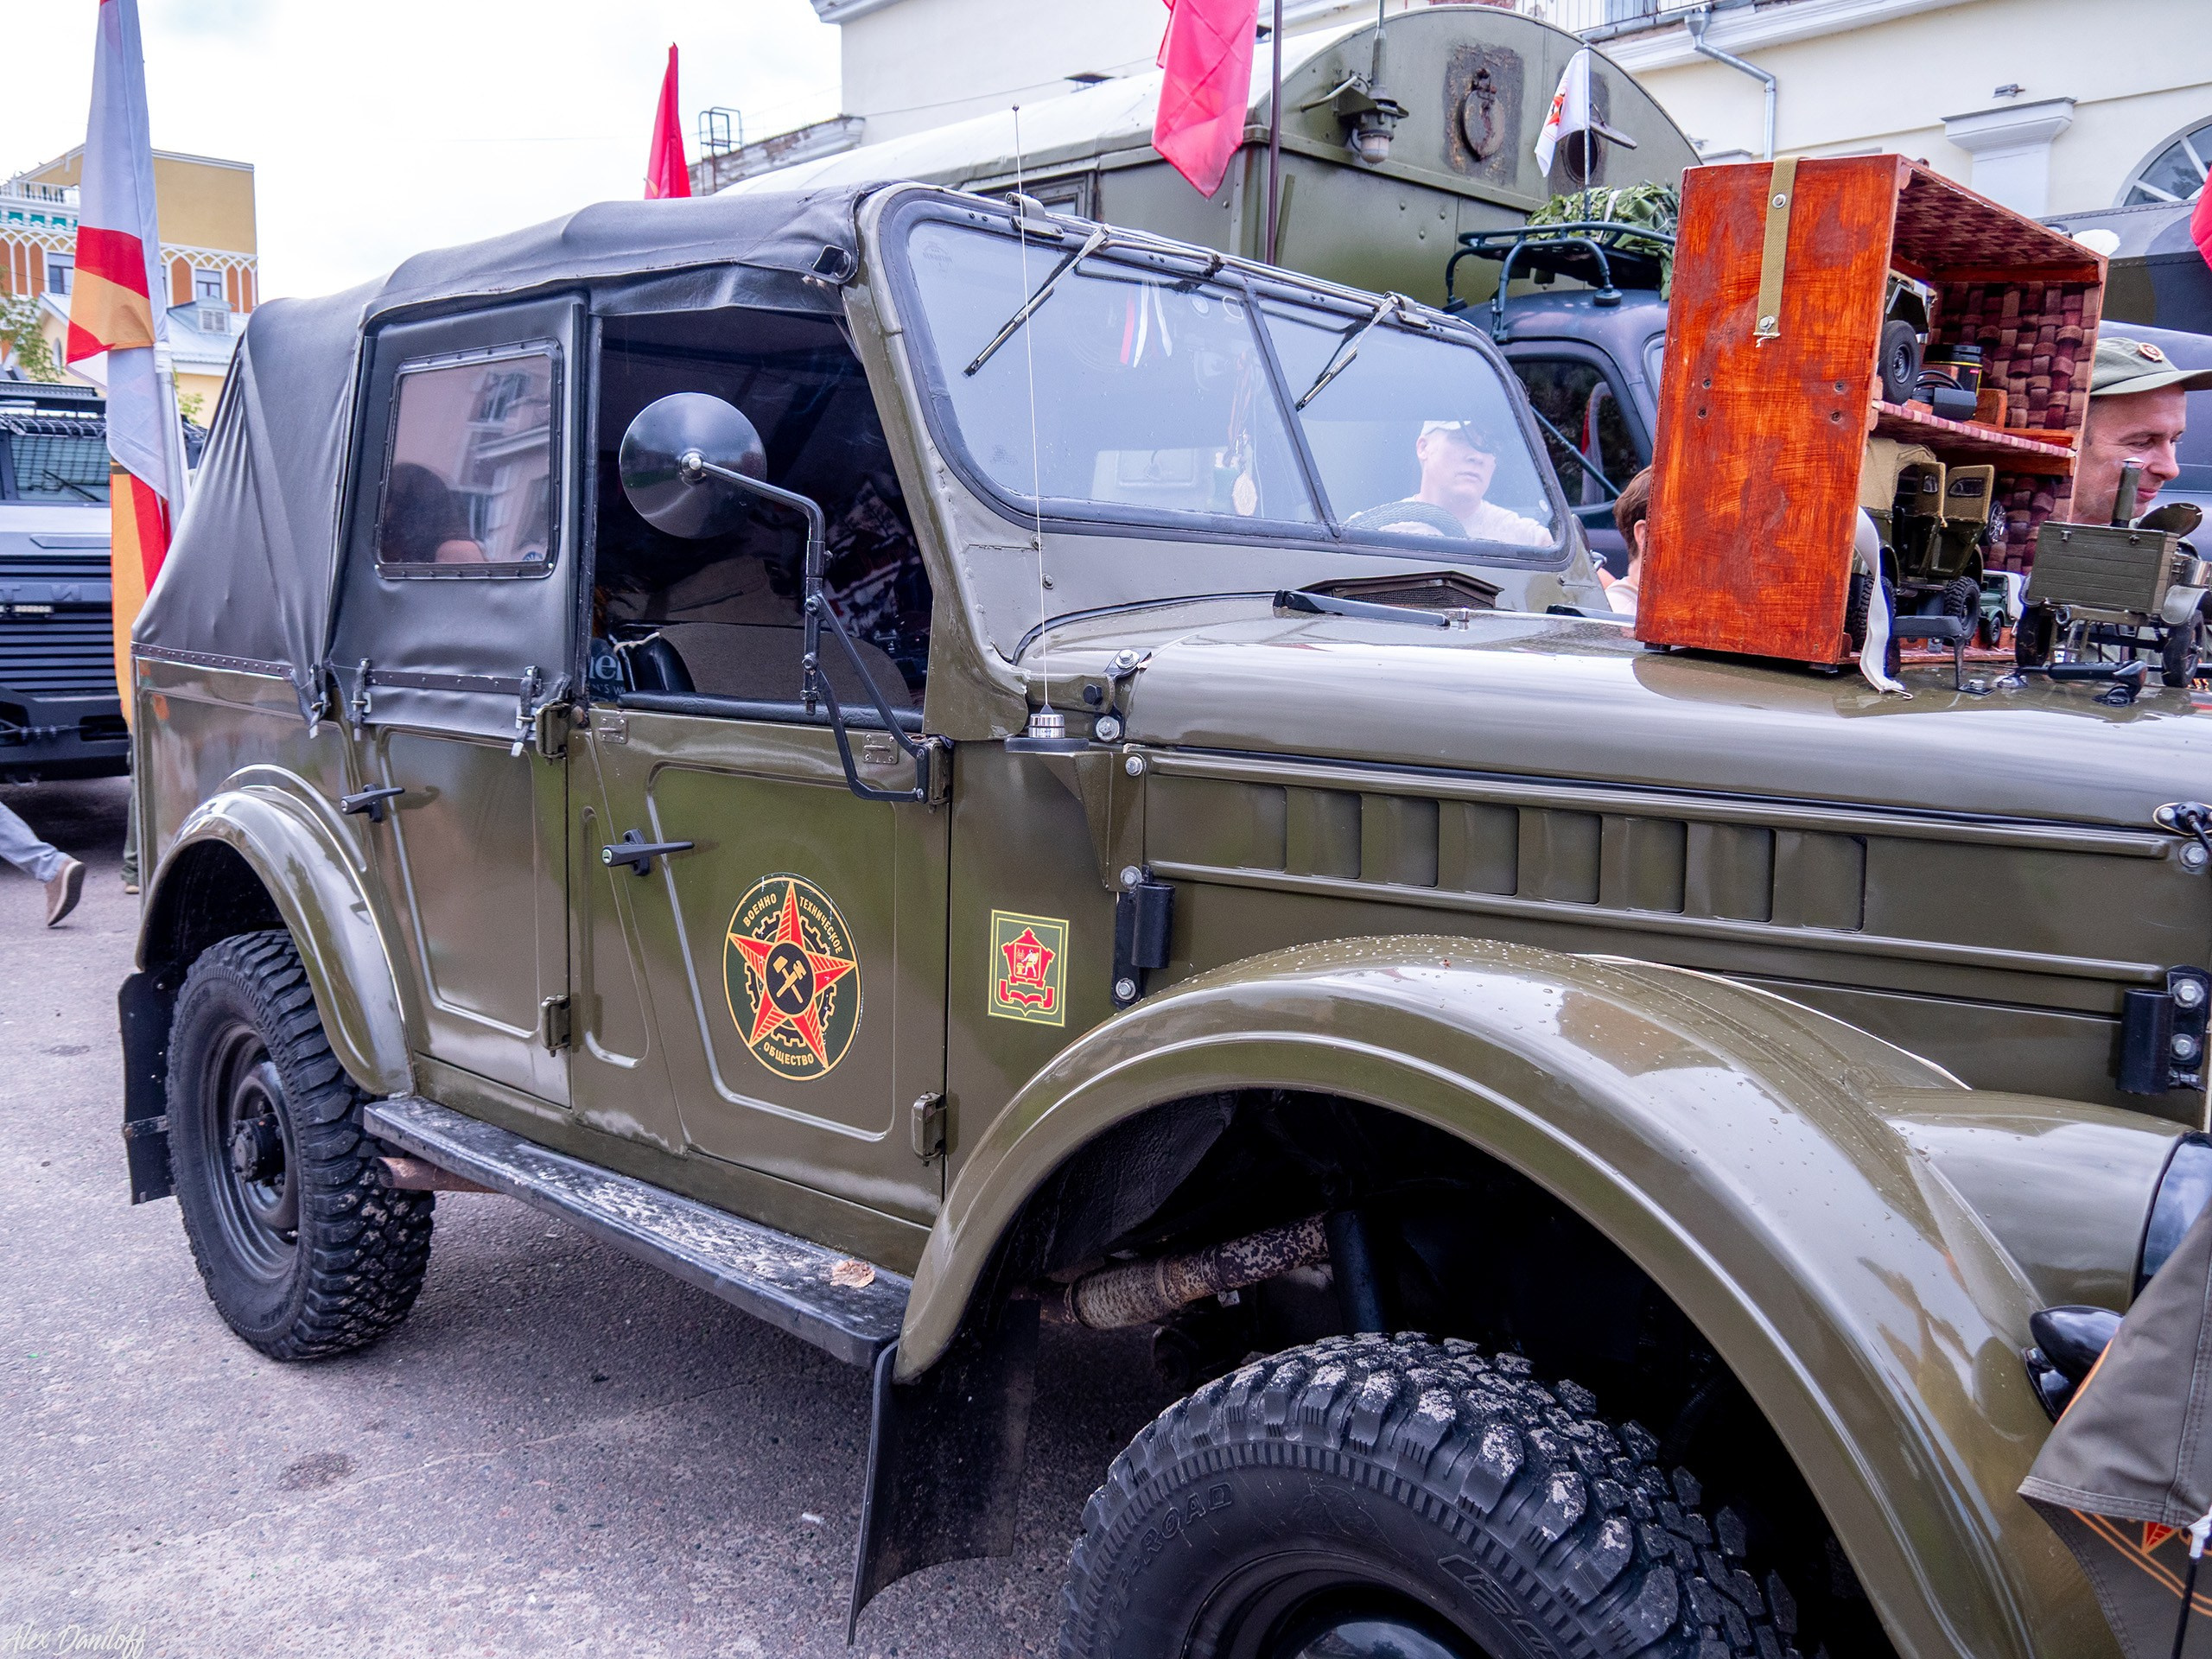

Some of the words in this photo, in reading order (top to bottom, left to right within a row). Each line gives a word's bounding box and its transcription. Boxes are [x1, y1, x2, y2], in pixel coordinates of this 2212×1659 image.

[742, 893, 778, 928] ВОЕННО
[799, 895, 843, 955] ТЕХНИЧЕСКОЕ
[763, 1041, 815, 1066] ОБЩЕСТВО
